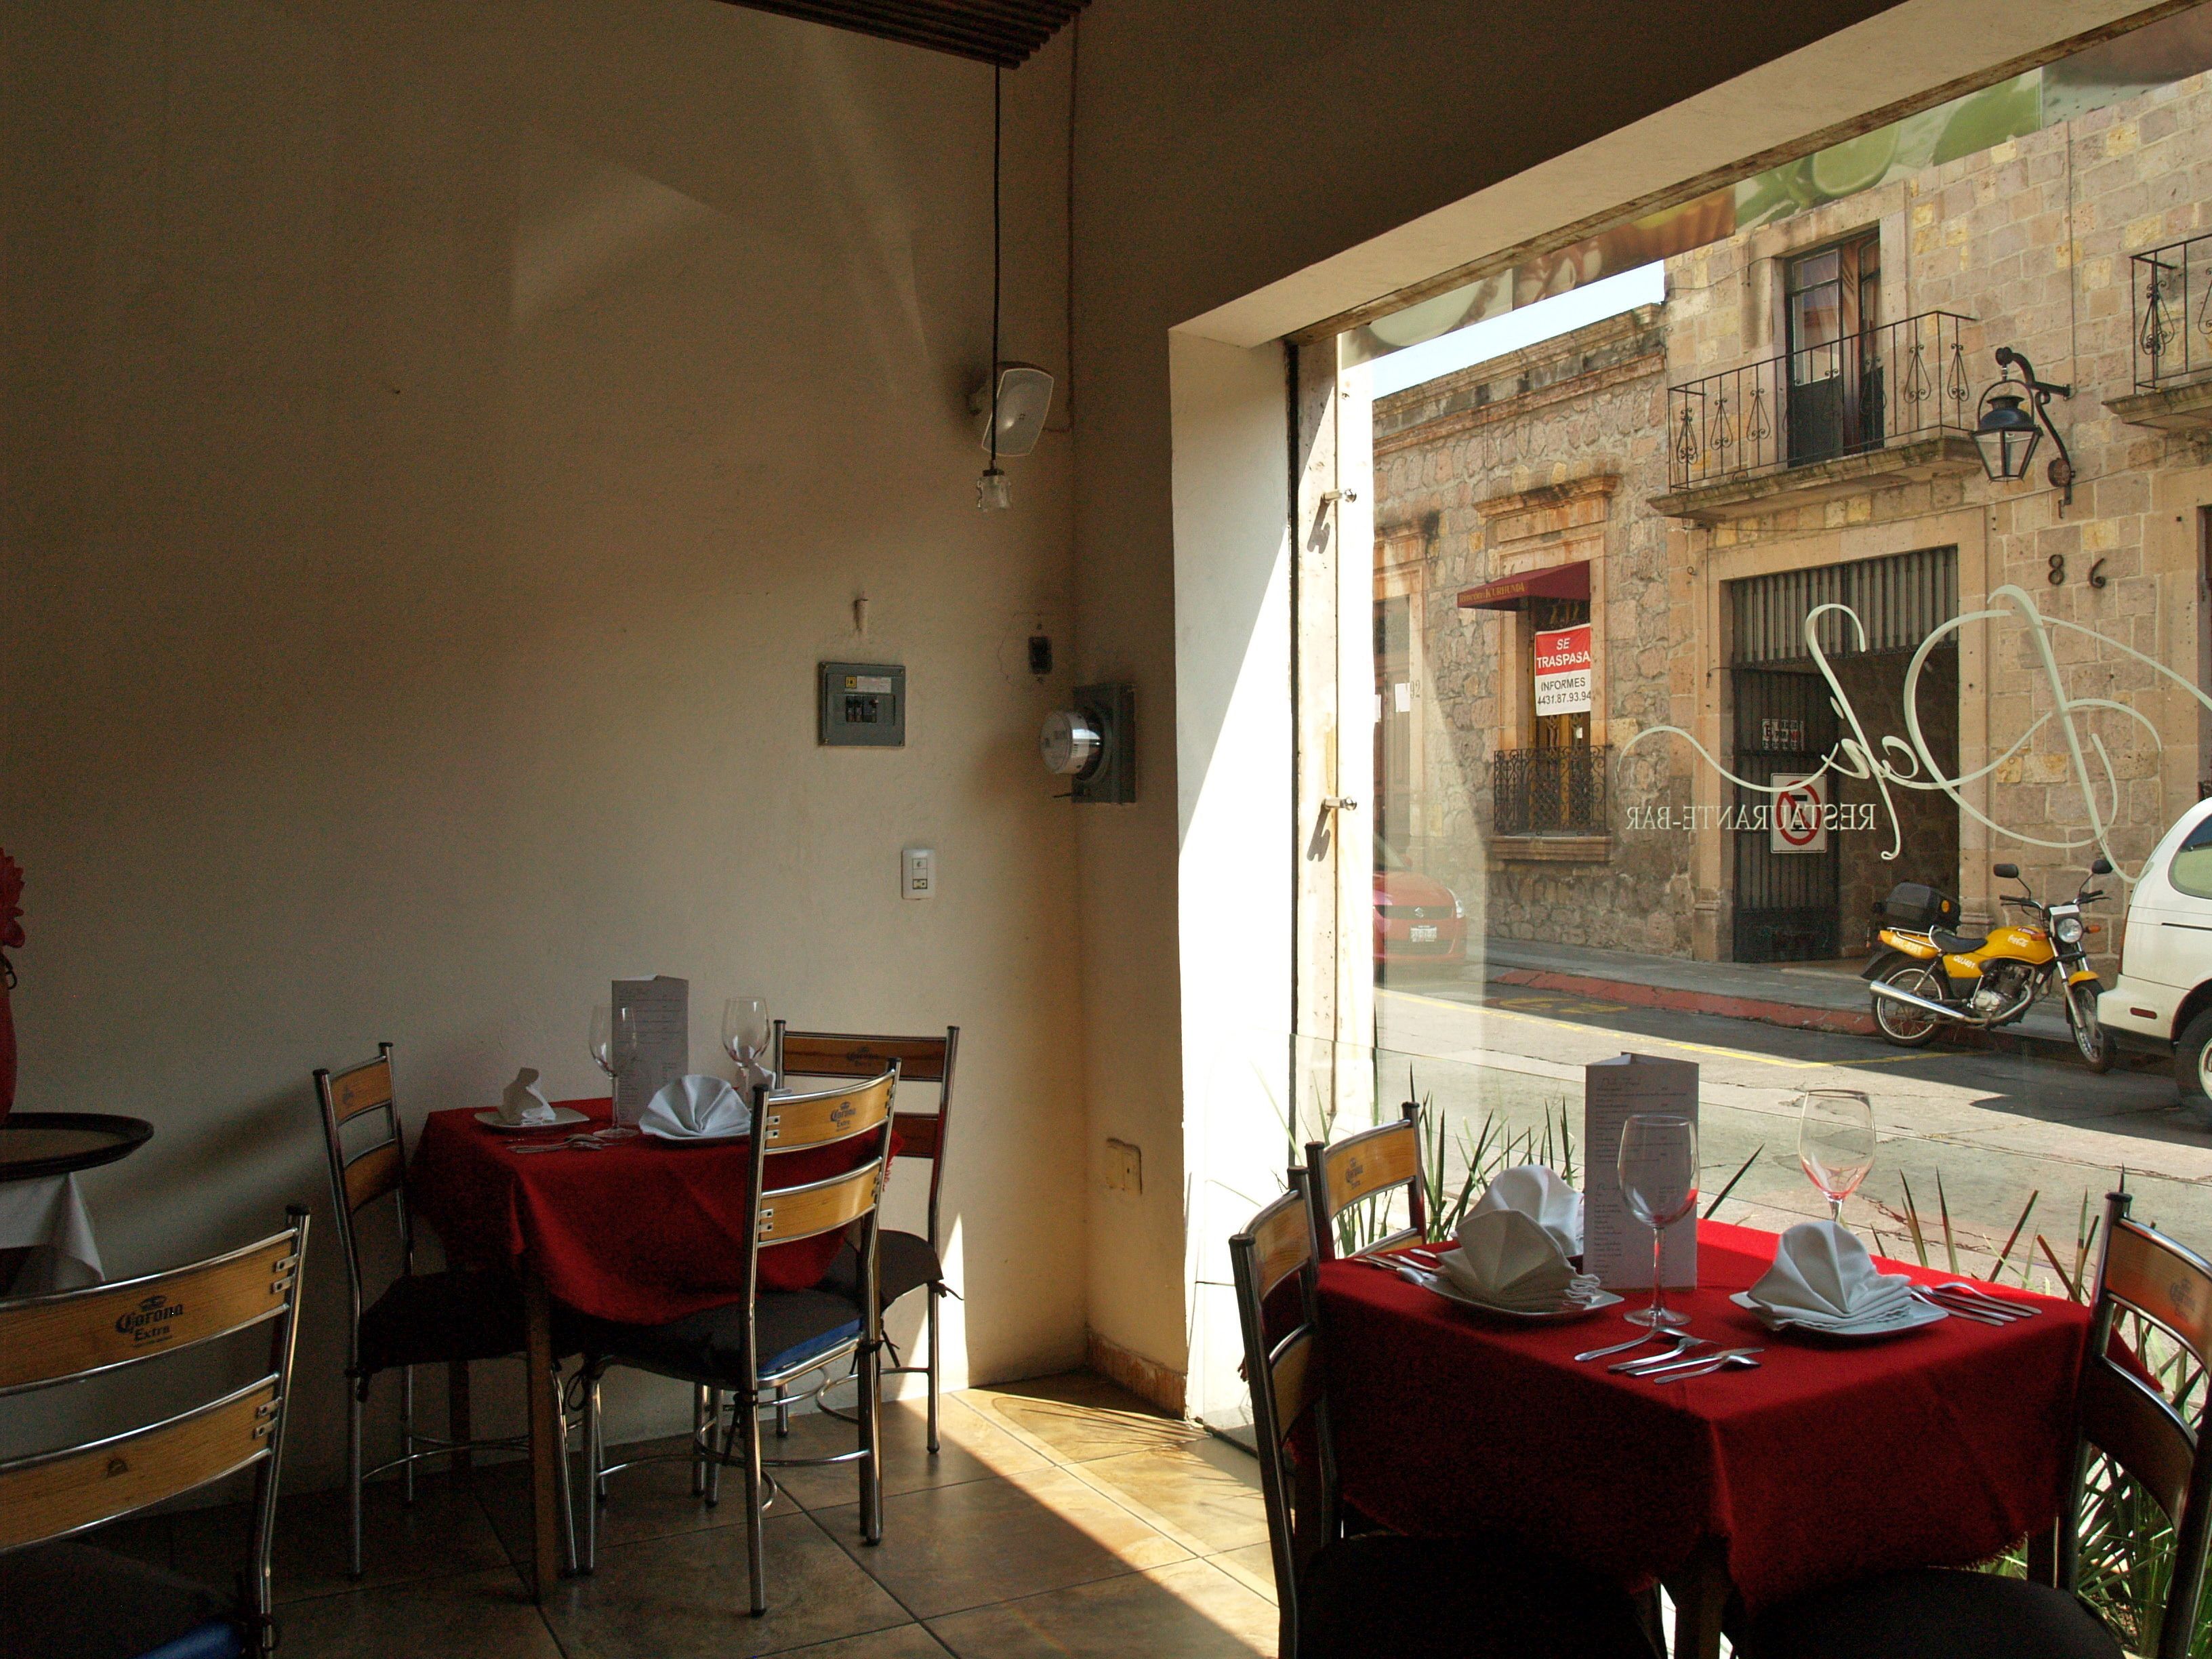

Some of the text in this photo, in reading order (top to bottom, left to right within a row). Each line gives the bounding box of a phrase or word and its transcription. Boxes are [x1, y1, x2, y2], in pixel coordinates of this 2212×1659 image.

[1556, 637, 1570, 651] SE
[1536, 650, 1591, 669] TRASPASA
[1541, 677, 1586, 692] INFORMES
[115, 1303, 184, 1334] Corona
[134, 1324, 170, 1342] Extra
